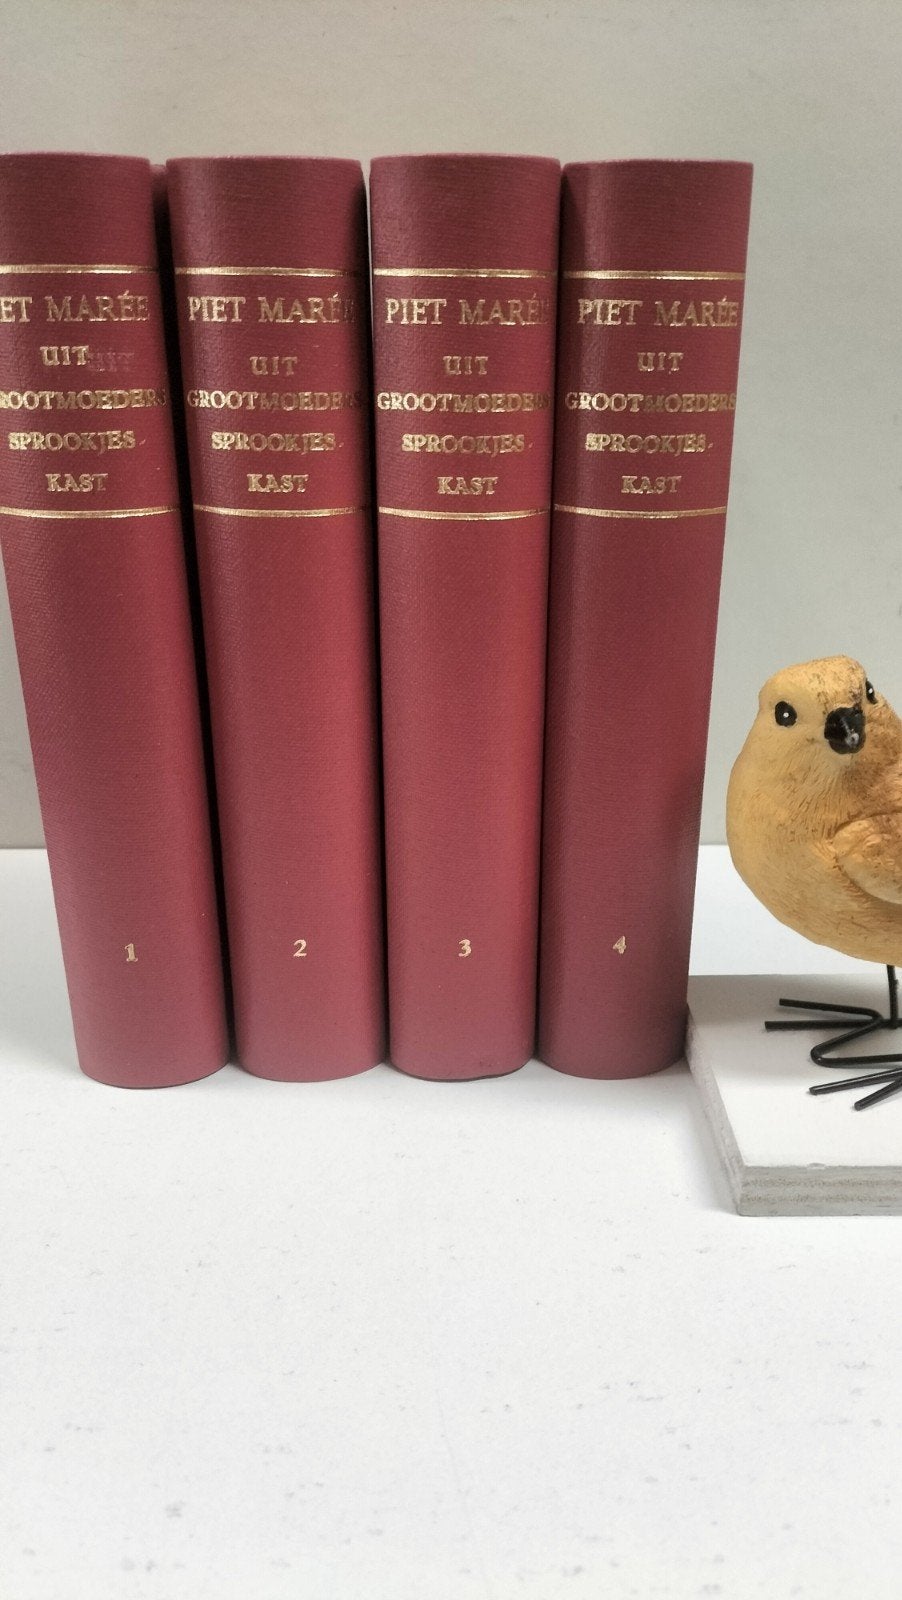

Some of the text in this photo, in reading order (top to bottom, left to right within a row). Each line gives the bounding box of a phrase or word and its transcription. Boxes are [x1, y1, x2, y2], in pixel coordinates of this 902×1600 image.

[44, 290, 150, 323] MARÉE
[187, 295, 247, 323] PIET
[385, 298, 448, 325] PIET
[577, 296, 740, 327] PIET MARÉE
[39, 345, 89, 366] UIT
[249, 355, 298, 375] UIT
[442, 355, 489, 375] UIT
[637, 352, 684, 374] UIT
[564, 391, 738, 413] GROOTMOEDERS
[44, 472, 109, 493] KAST
[246, 472, 309, 493] KAST
[436, 475, 499, 496] KAST
[620, 474, 682, 495] KAST
[124, 942, 139, 963] 1
[293, 938, 308, 958] 2
[458, 938, 472, 957] 3
[612, 935, 627, 955] 4
